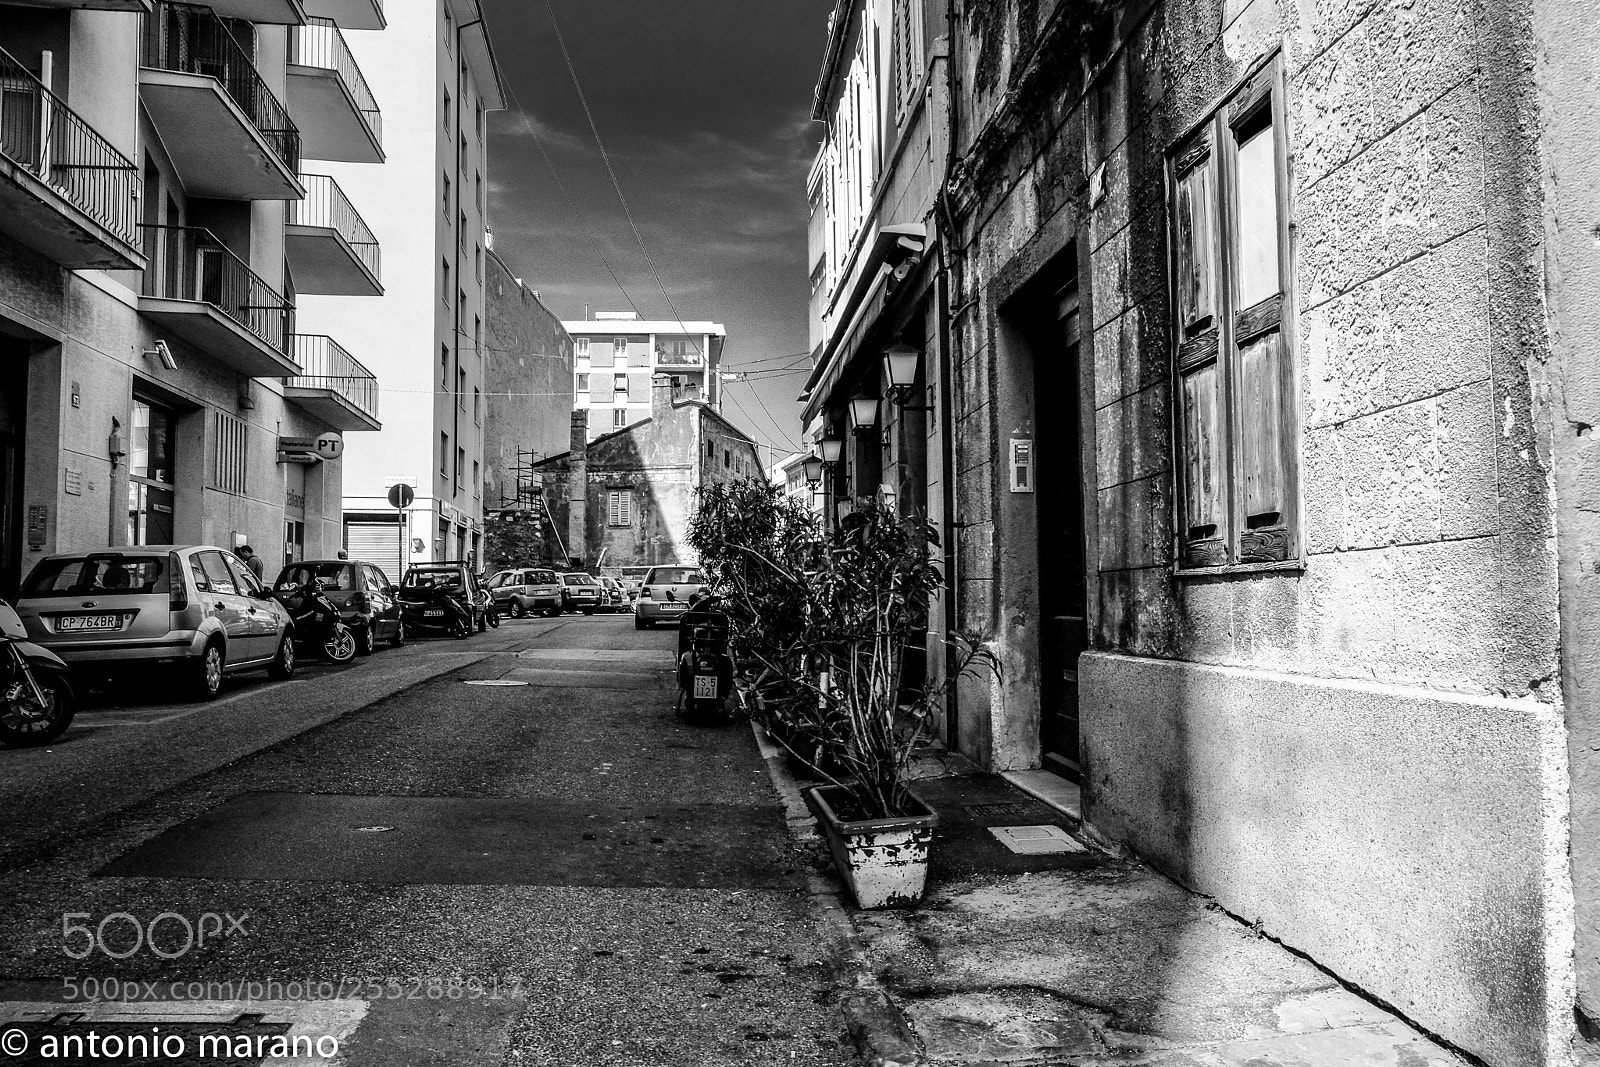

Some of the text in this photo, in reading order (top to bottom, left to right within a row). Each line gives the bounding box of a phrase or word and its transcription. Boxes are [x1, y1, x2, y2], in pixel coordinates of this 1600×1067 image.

[318, 439, 339, 451] PT
[62, 616, 114, 628] CP 764BR
[696, 687, 715, 697] 1121
